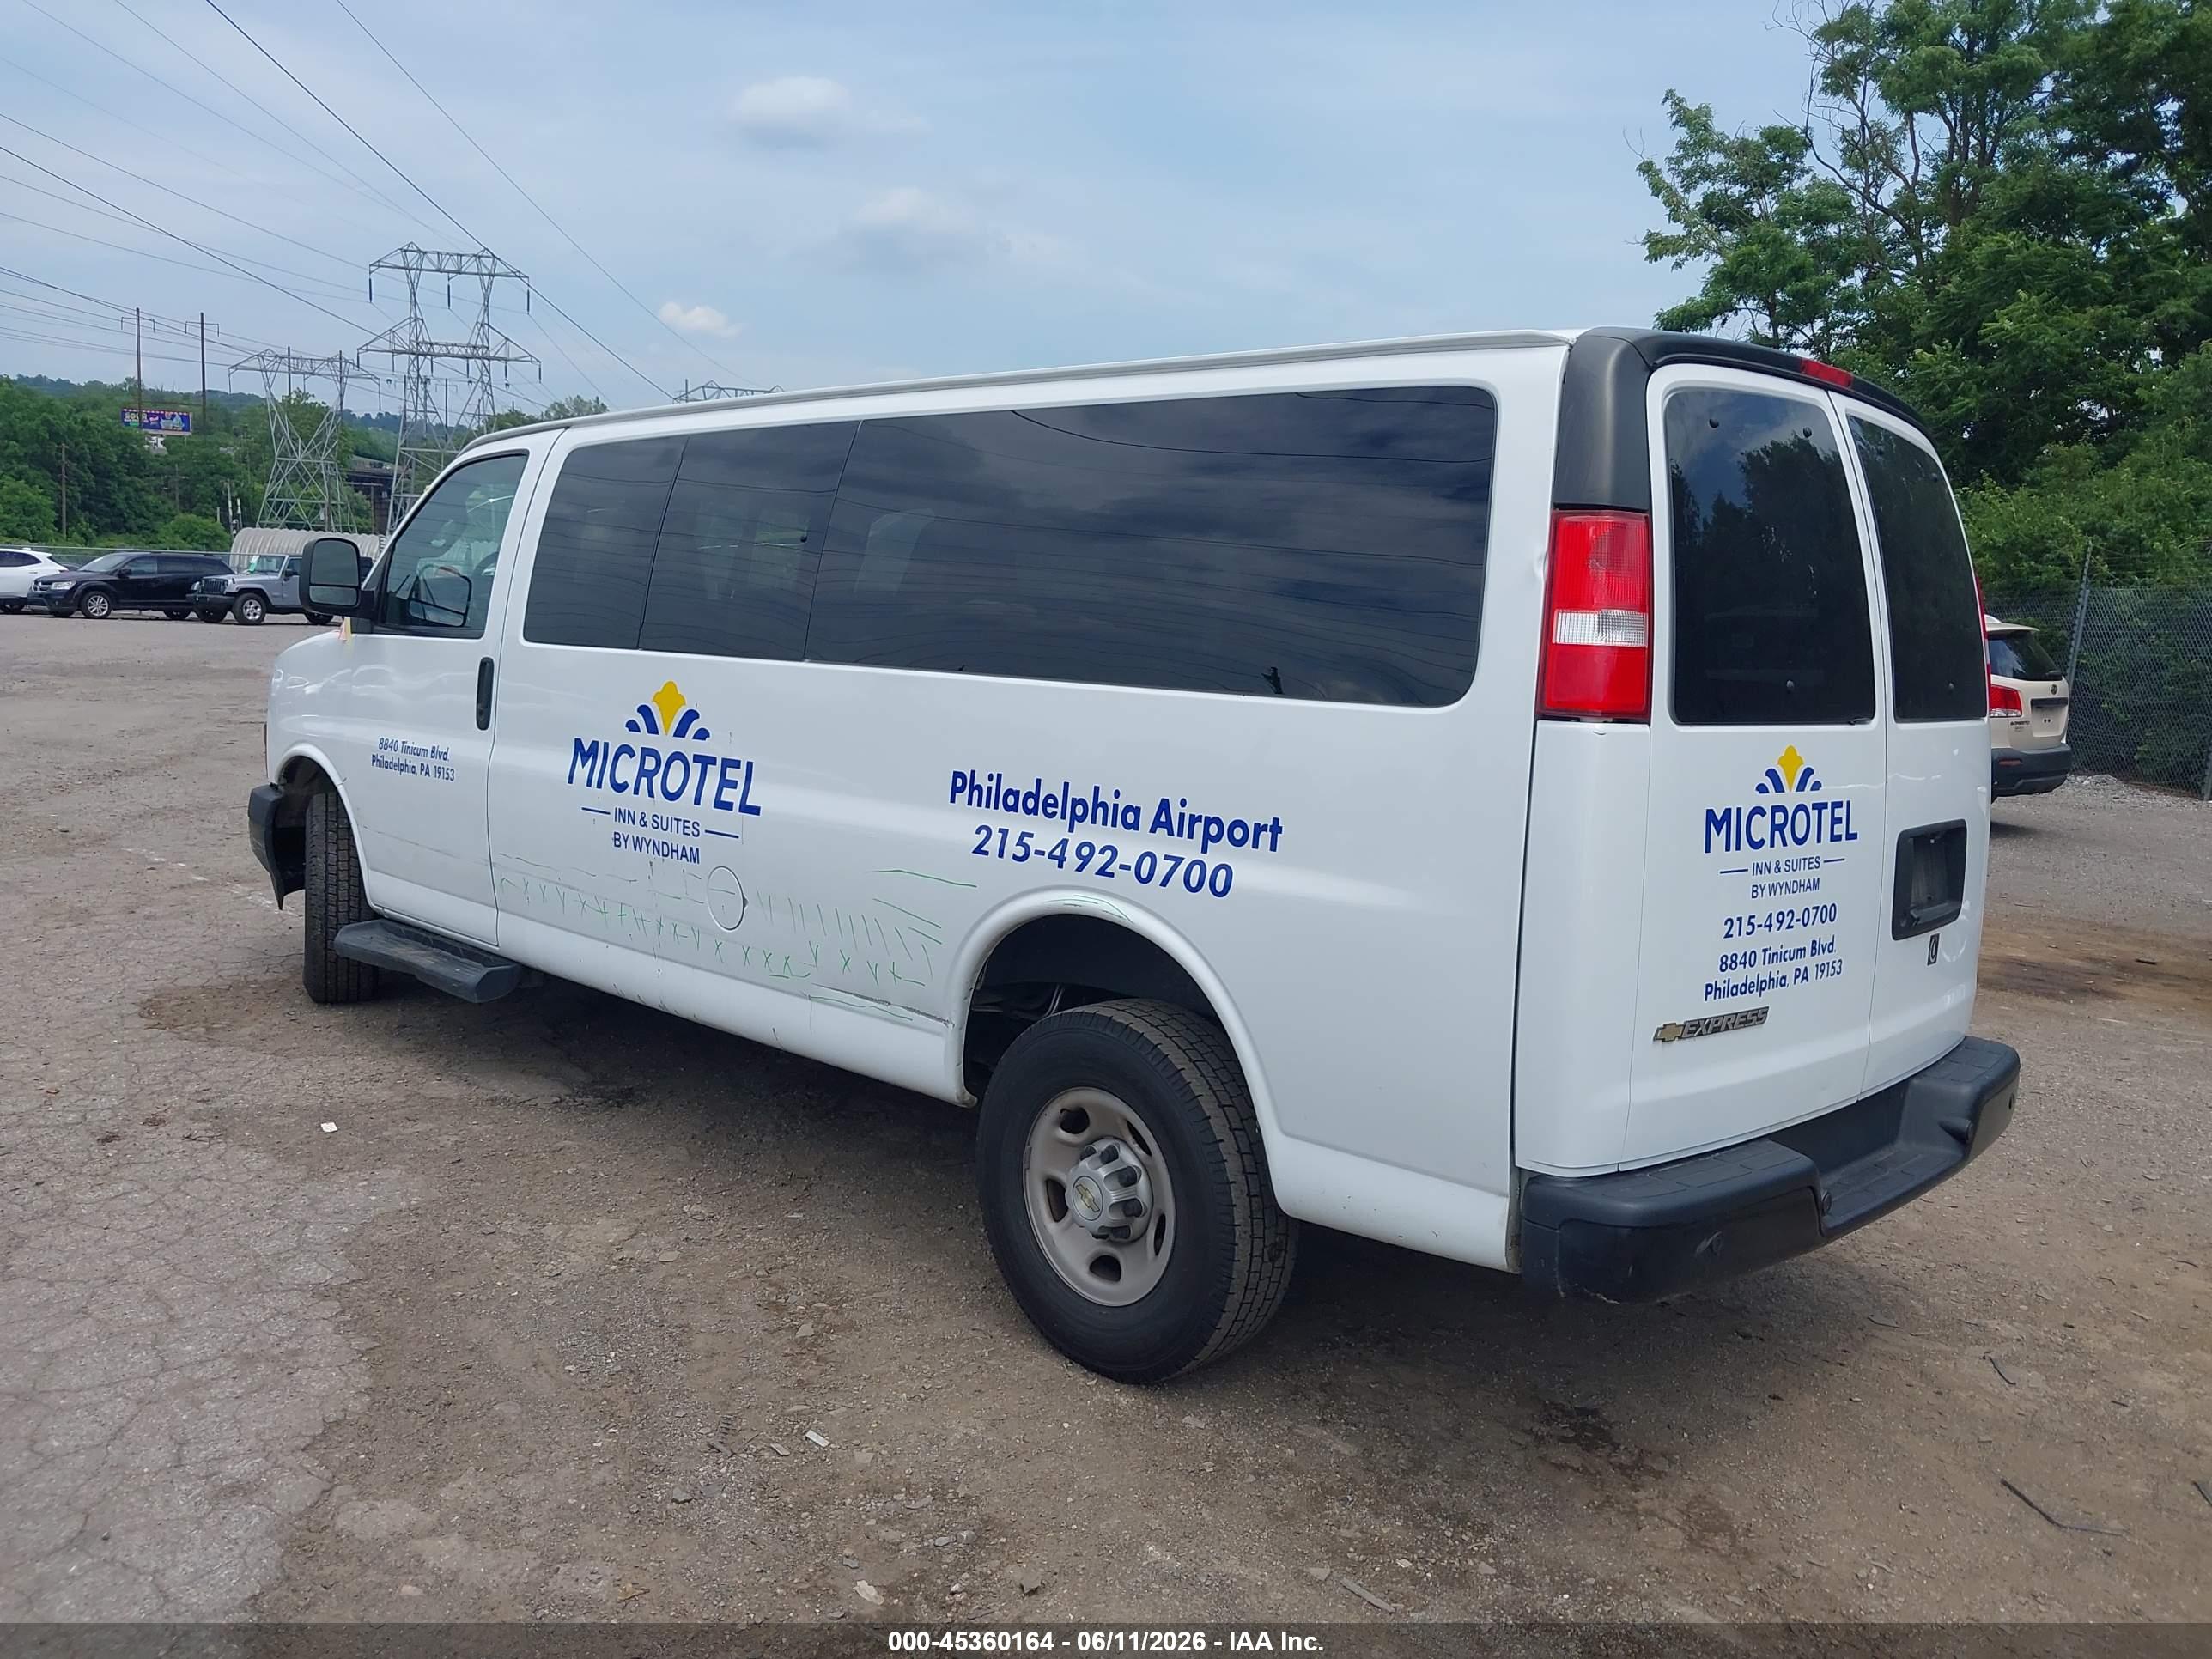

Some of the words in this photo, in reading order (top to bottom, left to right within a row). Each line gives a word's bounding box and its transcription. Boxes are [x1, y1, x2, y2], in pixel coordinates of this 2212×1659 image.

[379, 738, 398, 752] 8840
[401, 741, 428, 757] Tinicum
[430, 745, 449, 762] Blvd.
[372, 754, 417, 775] Philadelphia,
[420, 763, 430, 777] PA
[434, 765, 455, 781] 19153
[568, 738, 762, 817] MICROTEL
[614, 807, 635, 826] INN
[639, 812, 647, 828] &
[651, 814, 700, 837] SUITES
[950, 769, 1141, 833] Philadelphia
[1149, 798, 1283, 854] Airport
[1705, 800, 1857, 854] MICROTEL
[614, 831, 629, 848] BY
[632, 836, 700, 864] WYNDHAM
[972, 824, 1233, 898] 215-492-0700
[1752, 861, 1771, 876] INN
[1774, 860, 1782, 873] &
[1784, 856, 1820, 873] SUITES
[1751, 884, 1765, 899] BY
[1767, 878, 1820, 897] WYNDHAM
[1723, 903, 1837, 939] 215-492-0700
[1719, 951, 1757, 972] 8840
[1762, 944, 1807, 967] Tinicum
[1810, 935, 1836, 957] Blvd.
[1705, 971, 1790, 1001] Philadelphia,
[1794, 967, 1809, 983] PA
[1815, 959, 1843, 980] 19153
[1681, 1008, 1768, 1037] EXPRESS
